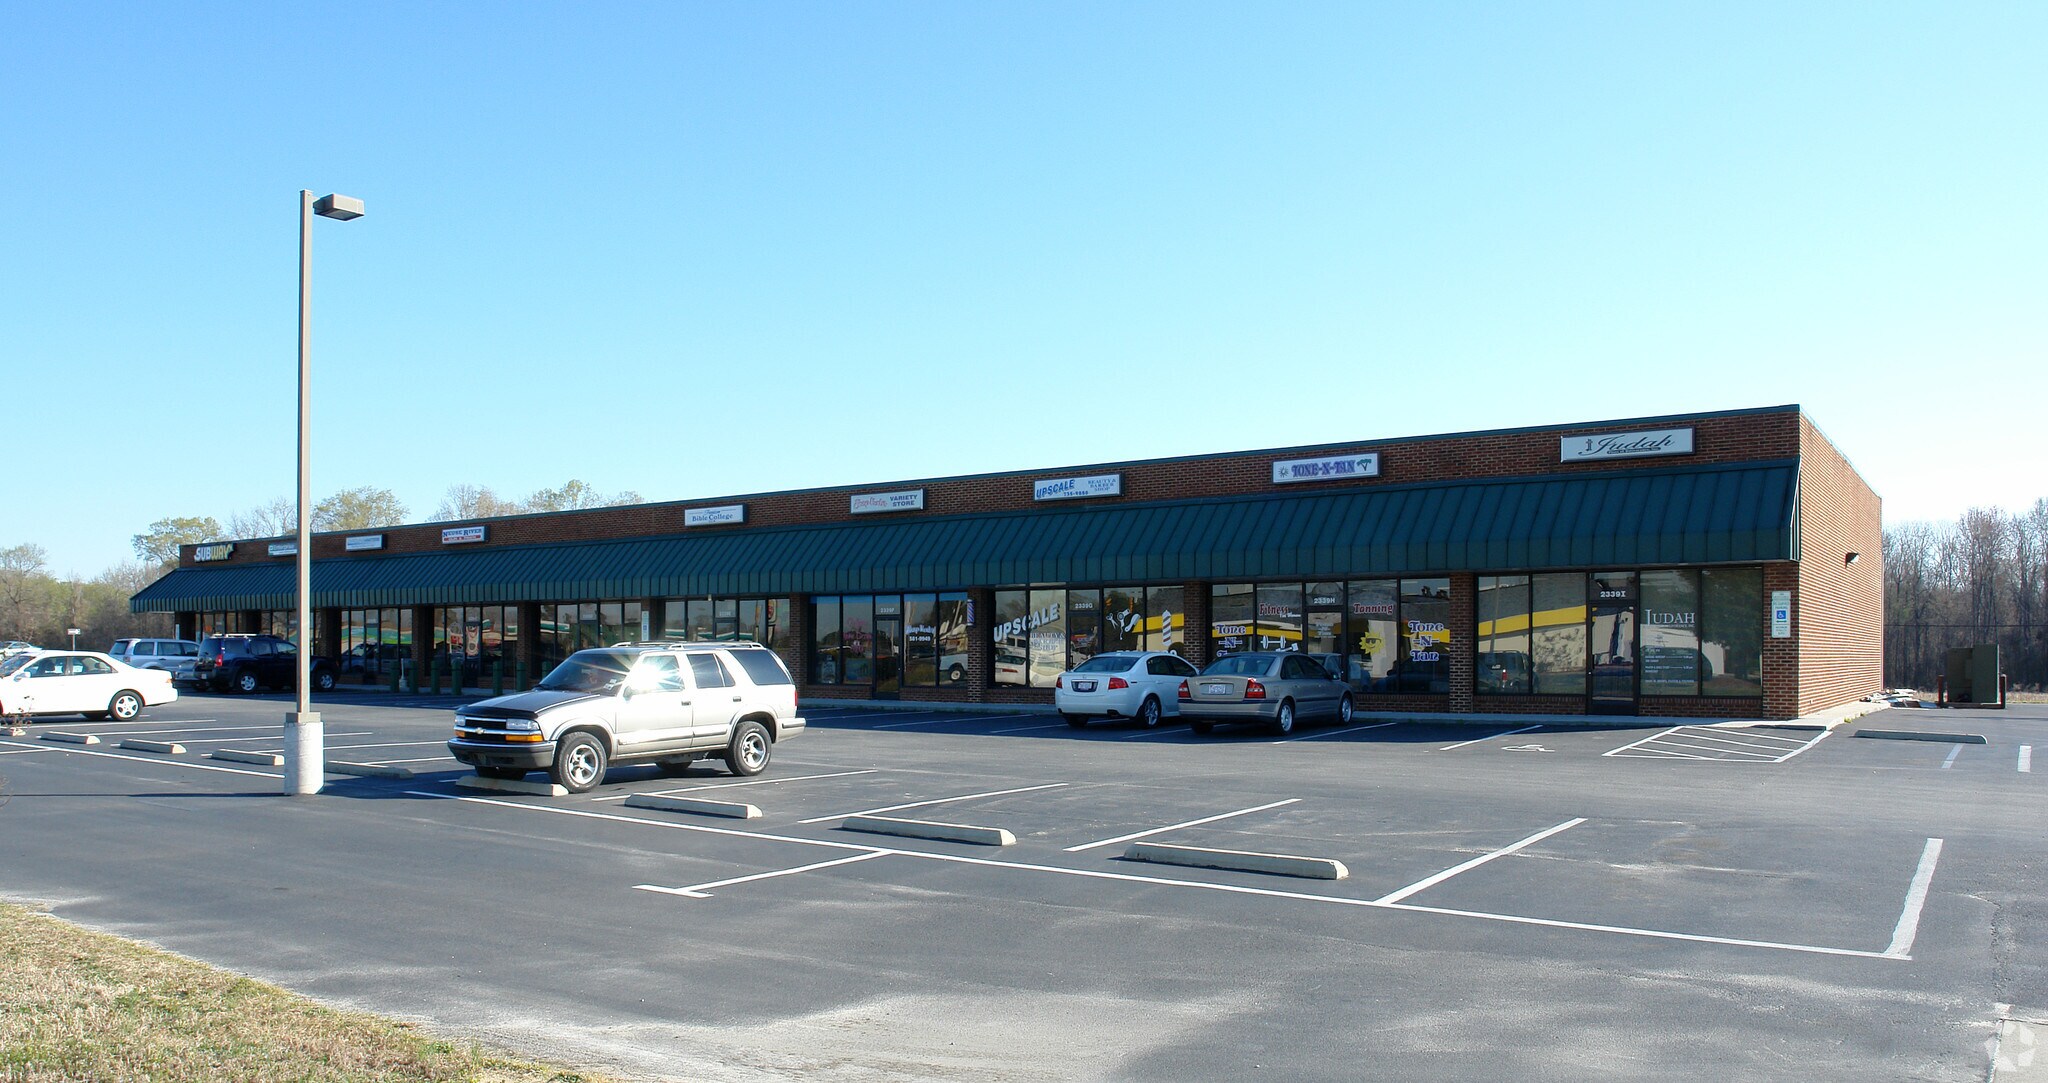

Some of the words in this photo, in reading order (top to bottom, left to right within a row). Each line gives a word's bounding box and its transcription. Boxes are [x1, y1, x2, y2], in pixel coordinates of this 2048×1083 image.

[1578, 434, 1676, 456] Judah
[1291, 459, 1356, 478] TONE-N-TAN
[1036, 480, 1075, 498] UPSCALE
[892, 500, 915, 508] STORE
[708, 513, 734, 521] College
[463, 528, 482, 536] RIVER
[194, 544, 235, 562] SUBWAY
[1259, 602, 1289, 616] Fitness
[1353, 602, 1394, 614] Tanning
[993, 603, 1060, 642] UPSCALE
[1645, 609, 1695, 625] JUDAH
[1215, 623, 1247, 635] Tone
[1408, 620, 1444, 632] Tone
[1410, 650, 1440, 661] Tan
